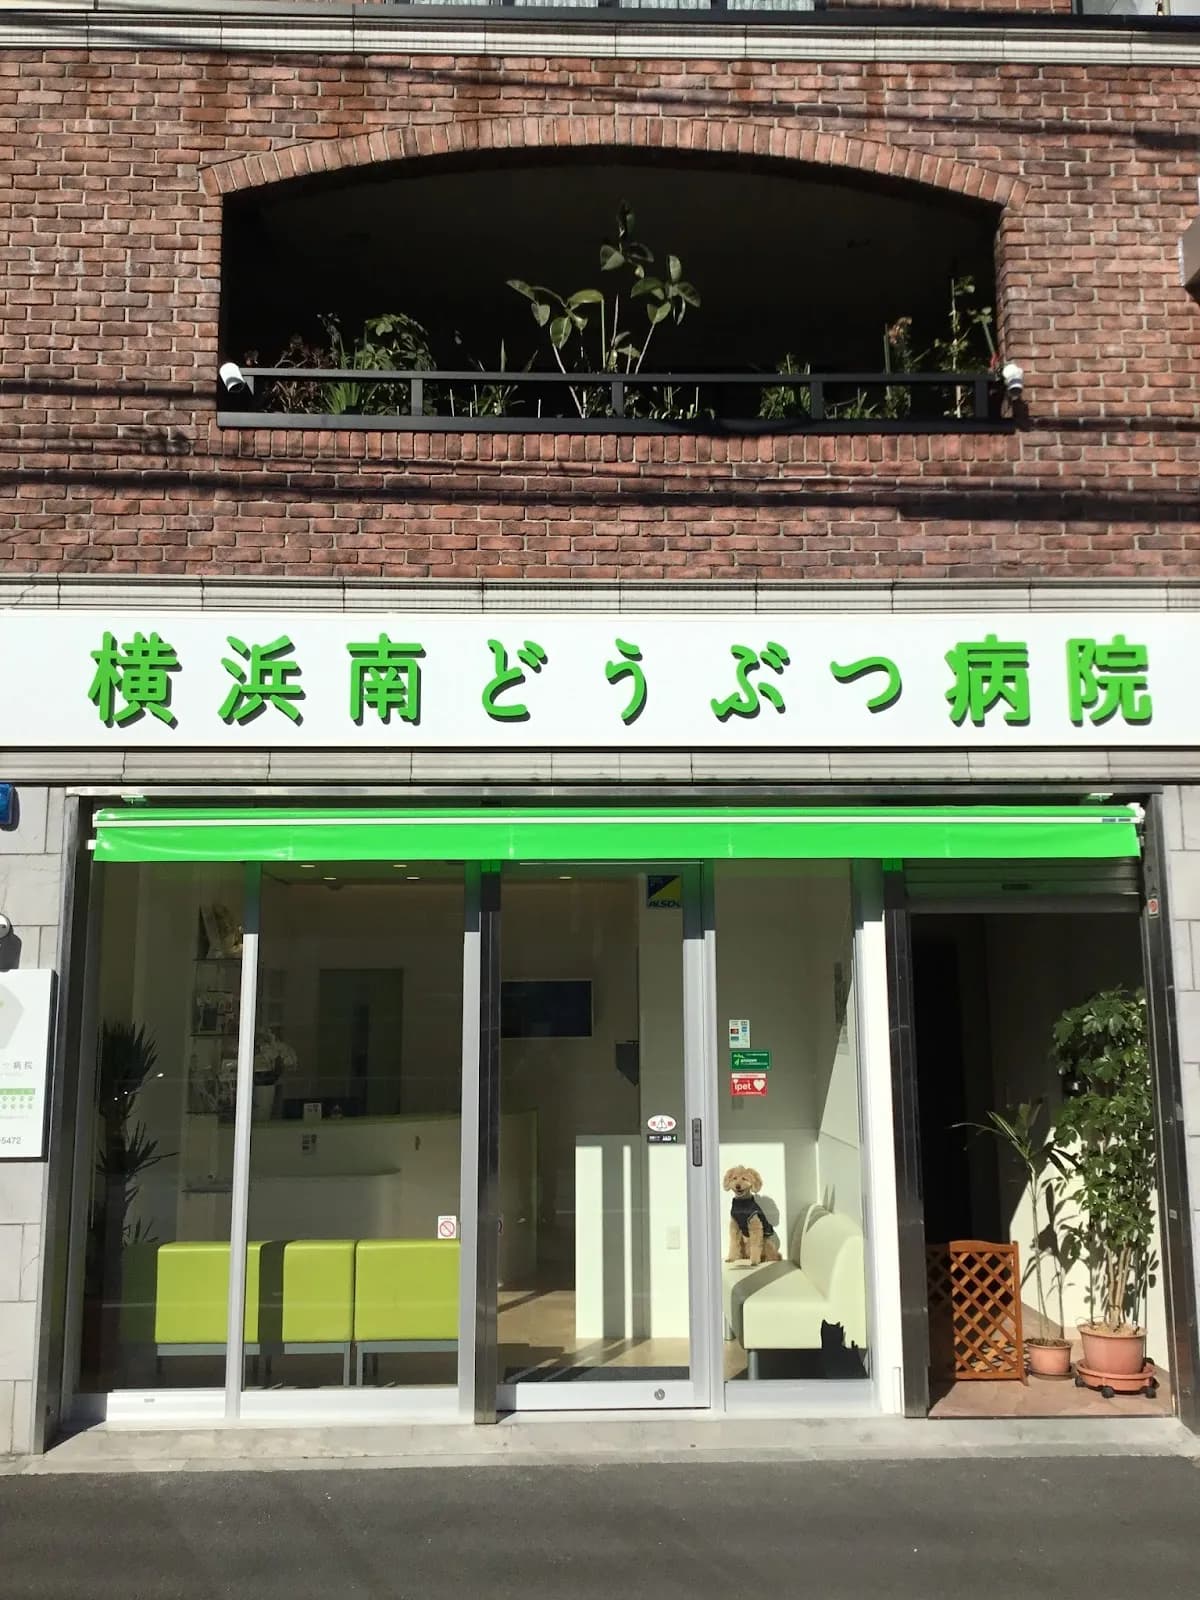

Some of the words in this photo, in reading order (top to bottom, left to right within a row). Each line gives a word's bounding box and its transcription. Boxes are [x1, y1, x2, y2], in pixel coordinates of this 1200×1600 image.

[88, 632, 1152, 723] 横浜南どうぶつ病院
[733, 1079, 752, 1092] ipet
